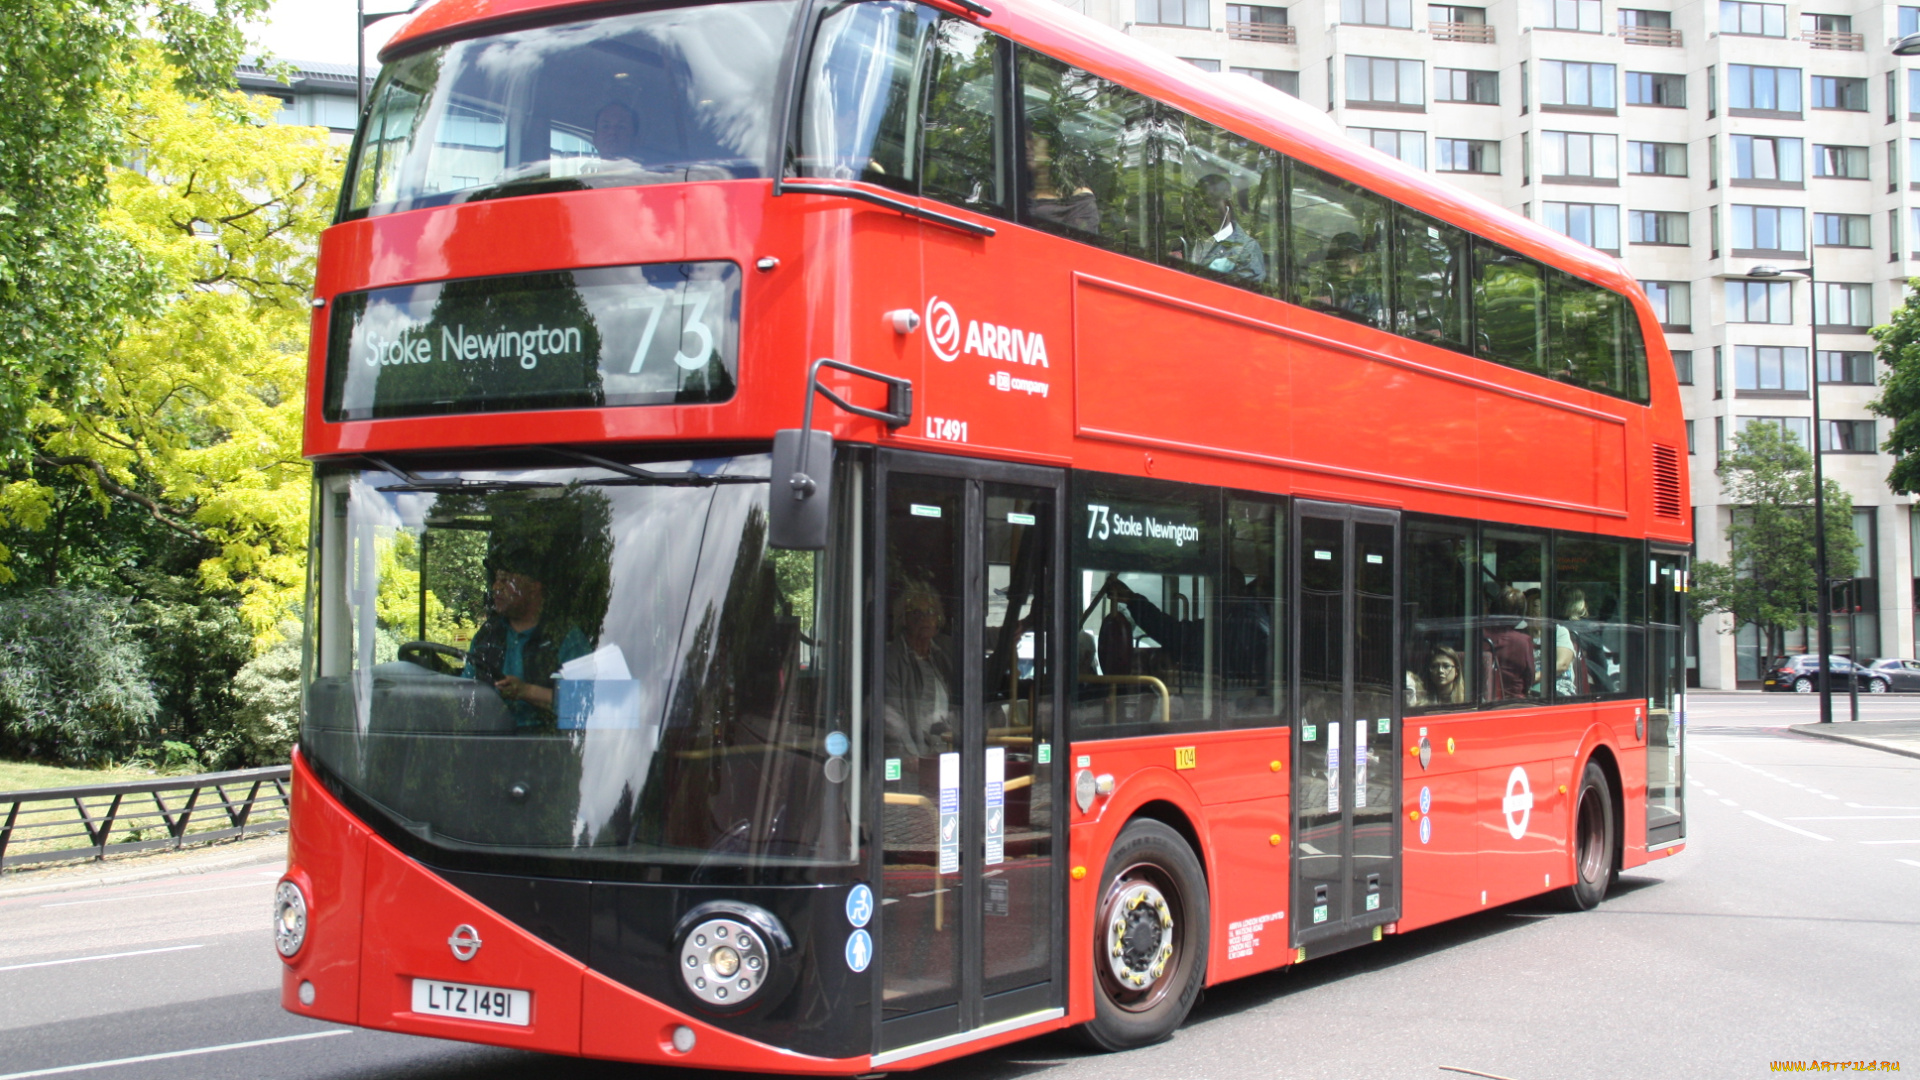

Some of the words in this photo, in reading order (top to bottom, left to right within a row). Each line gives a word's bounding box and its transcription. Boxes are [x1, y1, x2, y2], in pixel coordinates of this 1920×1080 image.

[365, 330, 432, 367] Stoke
[441, 323, 582, 371] Newington
[626, 290, 714, 374] 73
[963, 320, 1049, 369] ARRIVA
[988, 373, 997, 387] a
[1011, 377, 1050, 398] company
[926, 416, 968, 442] LT491
[1087, 504, 1110, 540] 73
[1113, 513, 1143, 537] Stoke
[1145, 516, 1199, 547] Newington
[1179, 749, 1195, 766] 104
